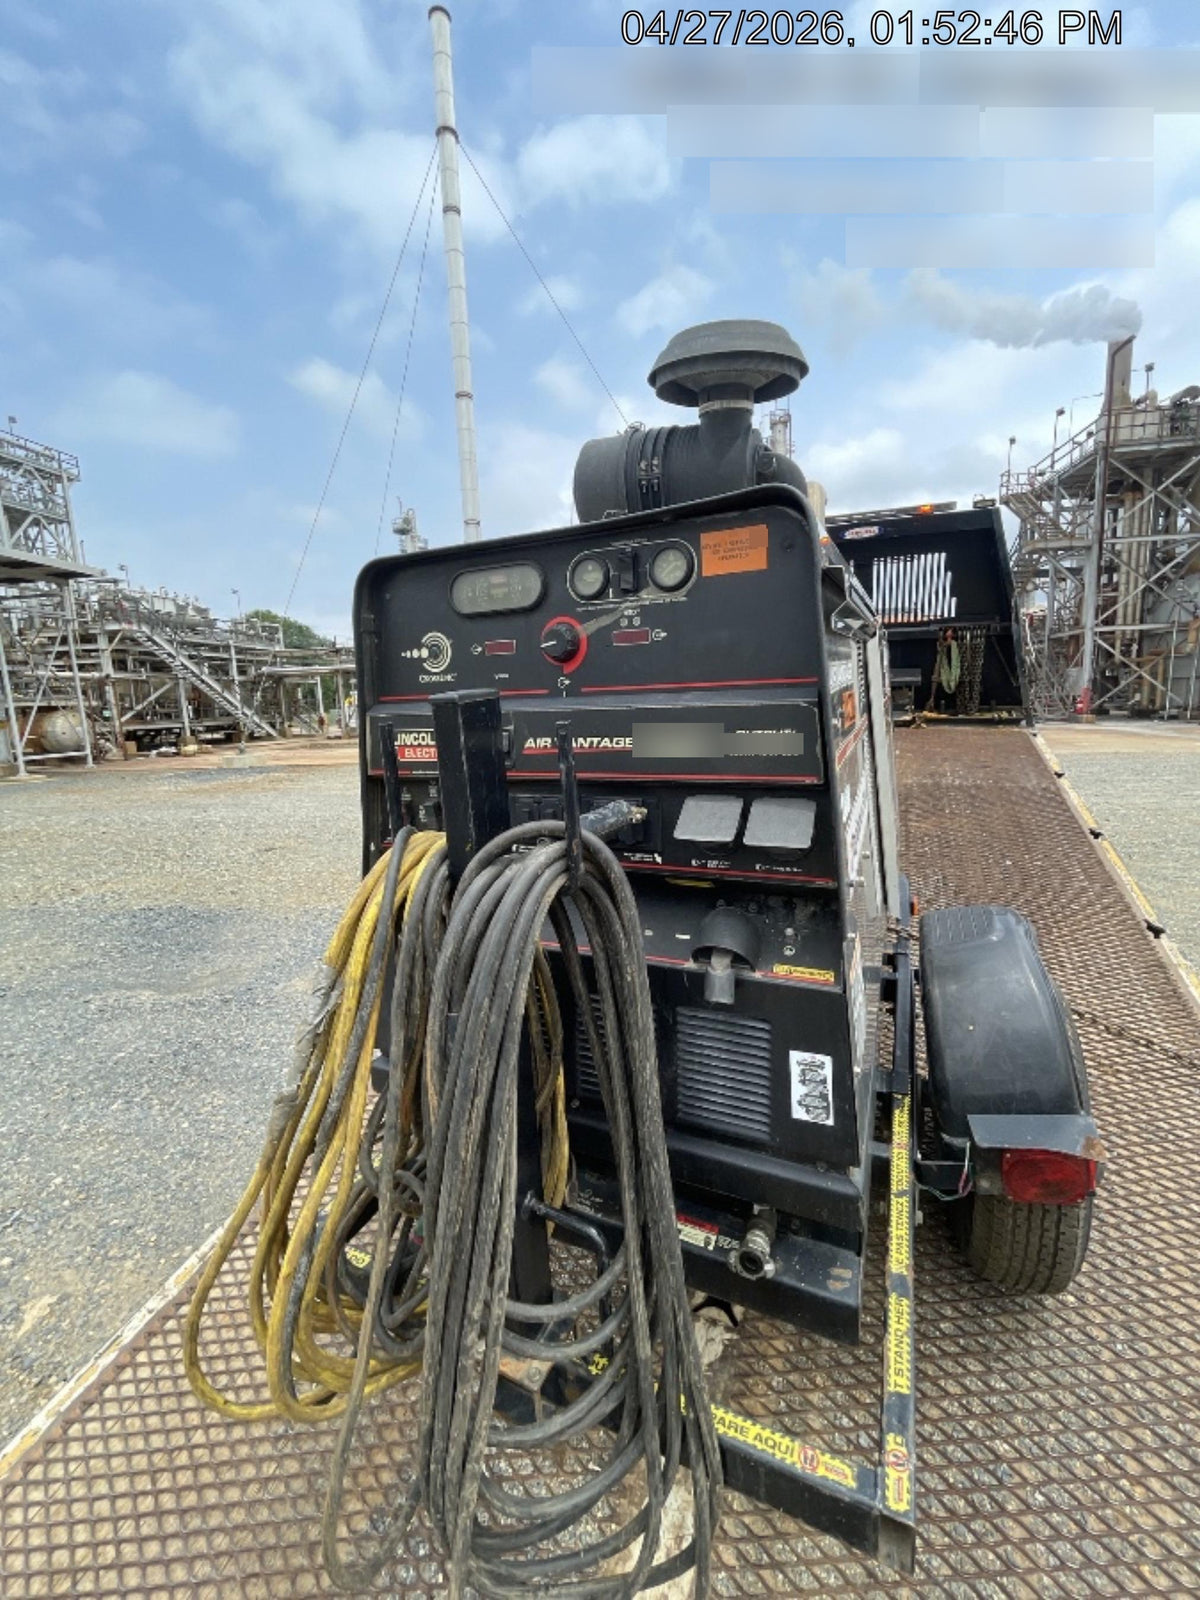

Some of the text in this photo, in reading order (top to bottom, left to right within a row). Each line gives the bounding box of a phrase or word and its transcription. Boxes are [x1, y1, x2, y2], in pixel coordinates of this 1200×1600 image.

[524, 736, 552, 749] AIR
[894, 1328, 904, 1378] STAND
[753, 1432, 795, 1459] AQUI
